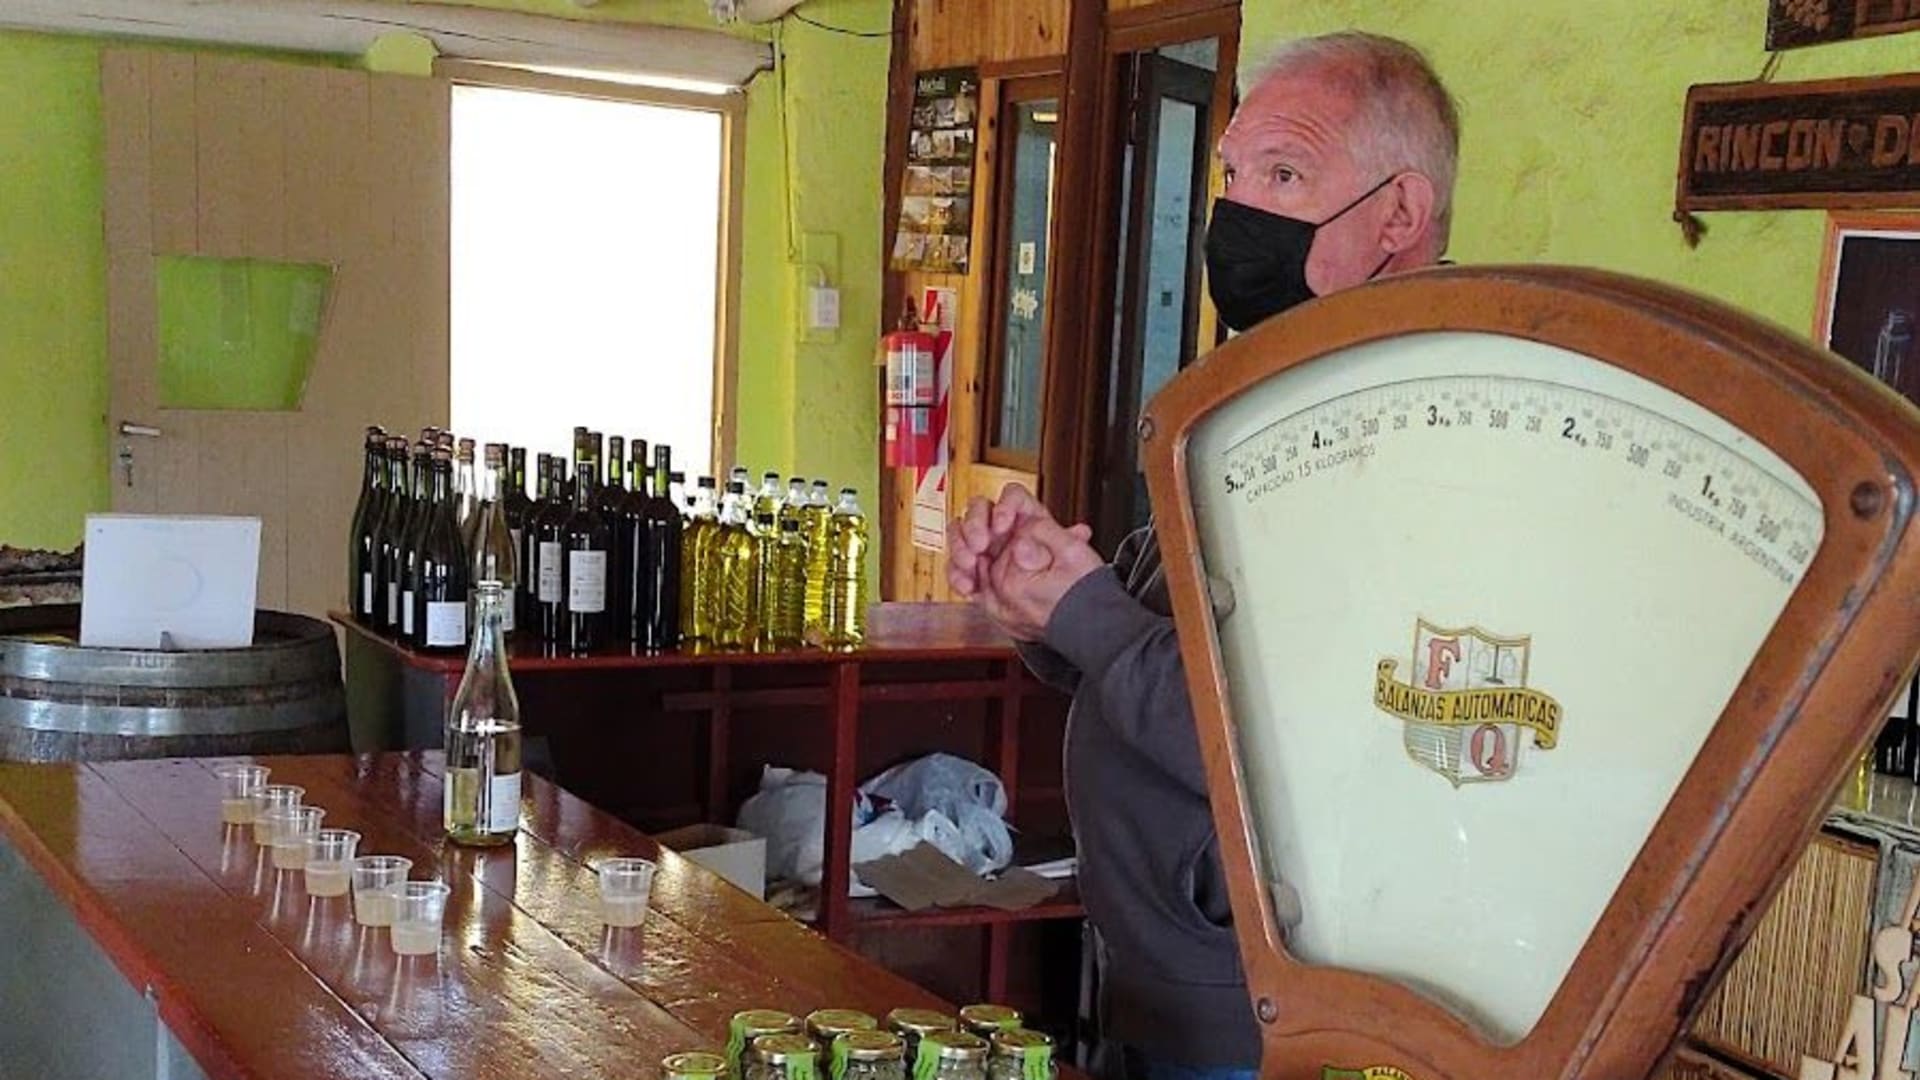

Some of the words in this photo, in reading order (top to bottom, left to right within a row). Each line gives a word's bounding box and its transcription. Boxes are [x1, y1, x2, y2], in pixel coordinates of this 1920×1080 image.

[1695, 118, 1846, 172] RINCON
[1362, 418, 1380, 437] 500
[1489, 409, 1509, 429] 500
[1525, 415, 1542, 433] 250
[1627, 443, 1649, 468] 500
[1756, 514, 1781, 543] 500
[1729, 531, 1794, 583] ARGENTINA
[1425, 637, 1461, 689] F
[1378, 680, 1446, 721] BALANZAS
[1452, 693, 1557, 732] AUTOMATICAS
[1470, 723, 1509, 777] Q
